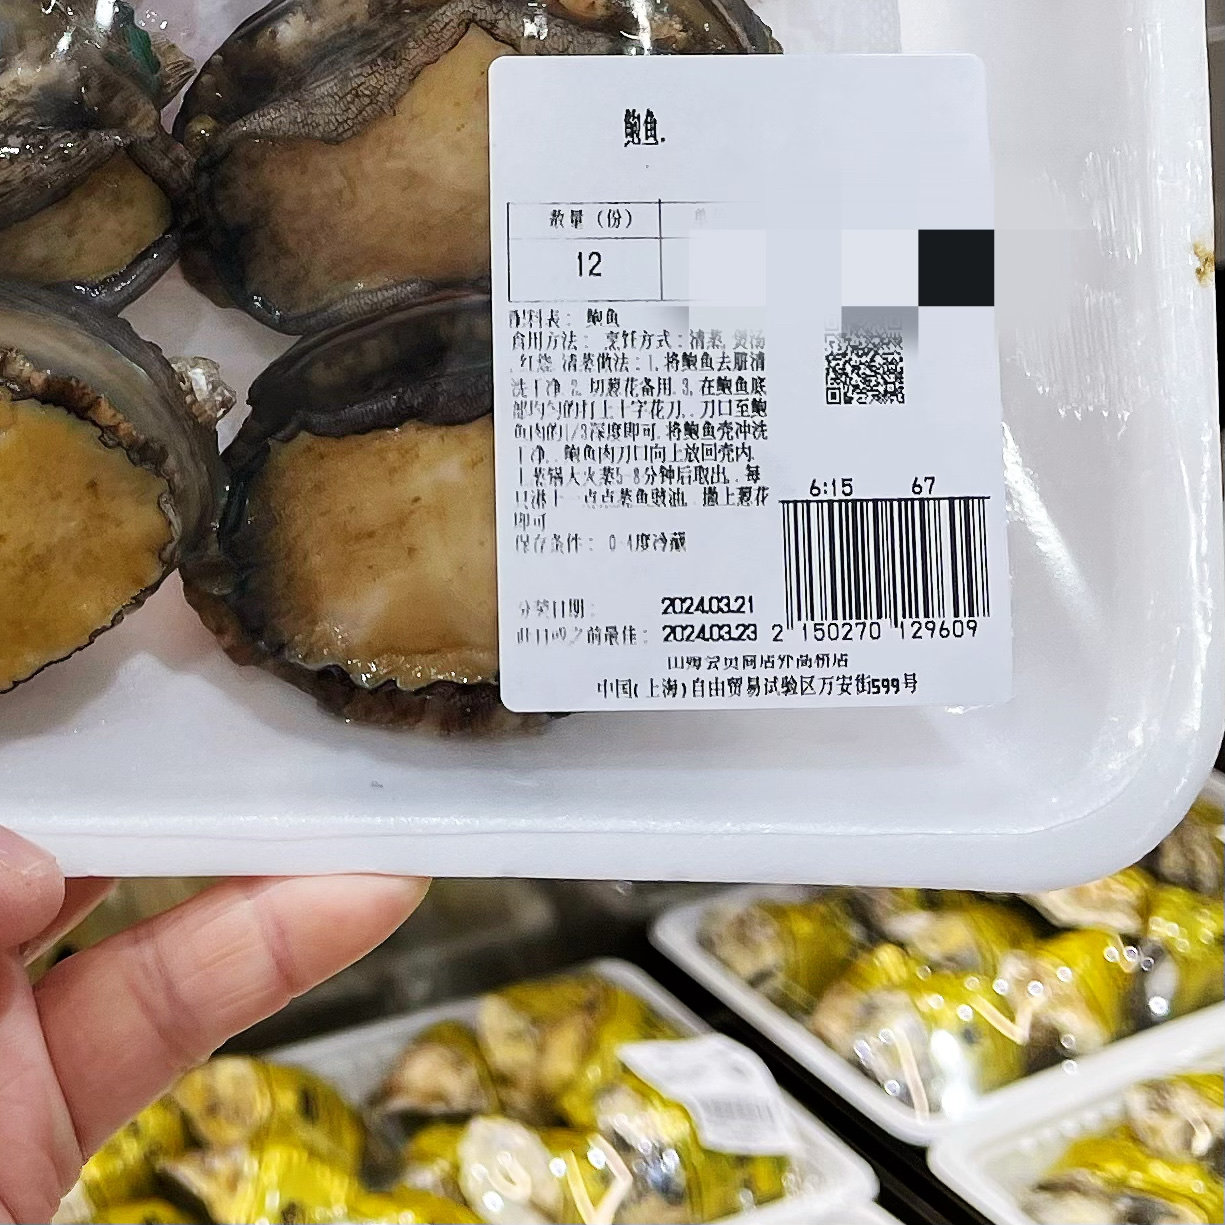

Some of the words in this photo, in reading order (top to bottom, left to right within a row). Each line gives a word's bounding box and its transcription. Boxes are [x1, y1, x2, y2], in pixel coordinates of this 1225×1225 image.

[576, 251, 603, 278] 12
[911, 476, 936, 495] 67
[661, 595, 754, 615] 2024.03.21
[662, 623, 758, 642] 2024.03.23
